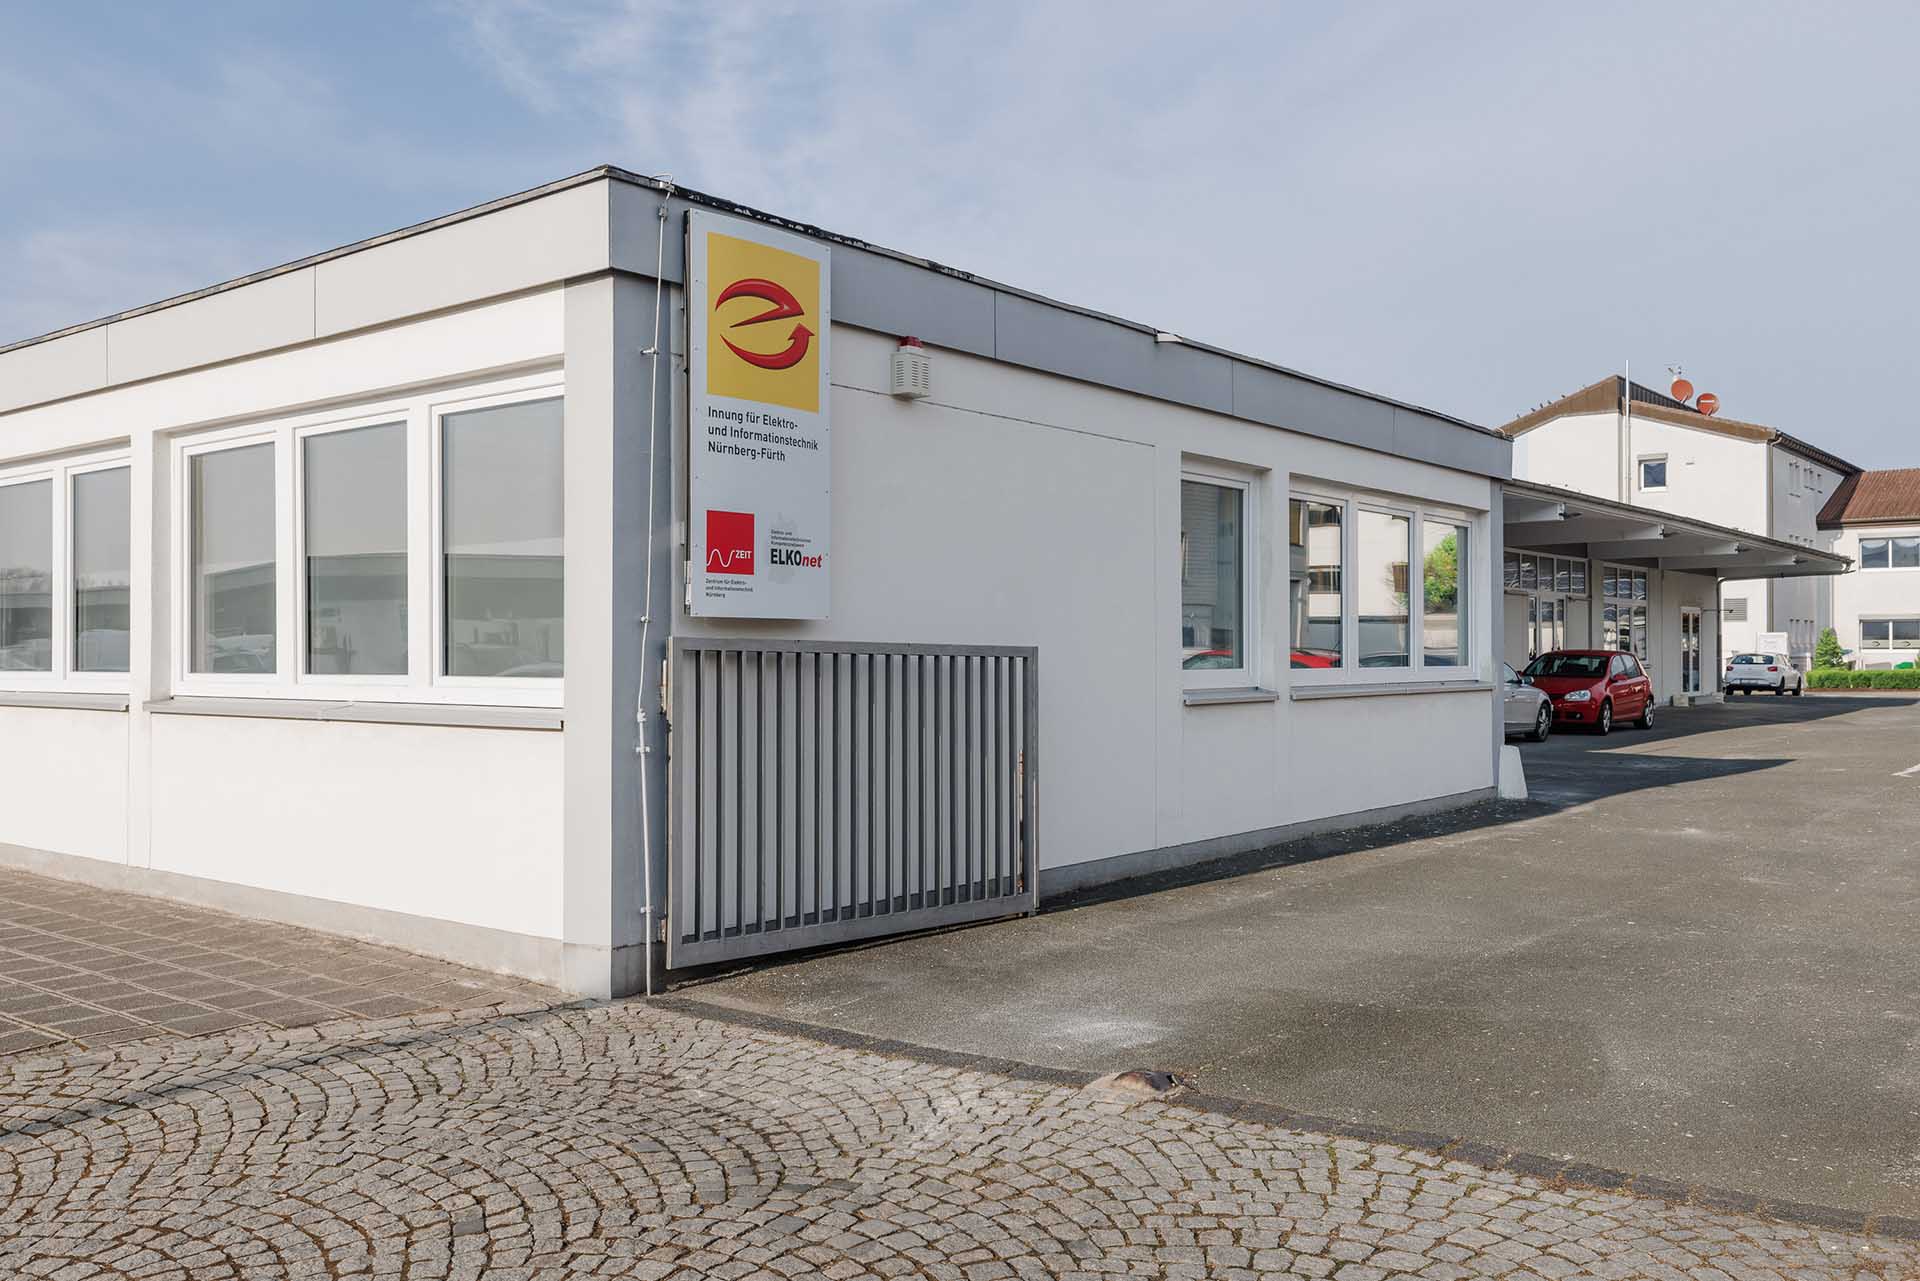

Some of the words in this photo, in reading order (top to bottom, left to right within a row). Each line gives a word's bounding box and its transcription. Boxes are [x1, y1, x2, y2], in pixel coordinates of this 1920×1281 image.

[708, 406, 743, 424] Innung
[746, 411, 760, 424] für
[762, 414, 798, 430] Elektro-
[708, 425, 727, 436] und
[730, 426, 819, 450] Informationstechnik
[708, 441, 786, 461] Nürnberg-Fürth
[735, 549, 752, 559] ZEIT
[771, 548, 822, 568] ELKOnet
